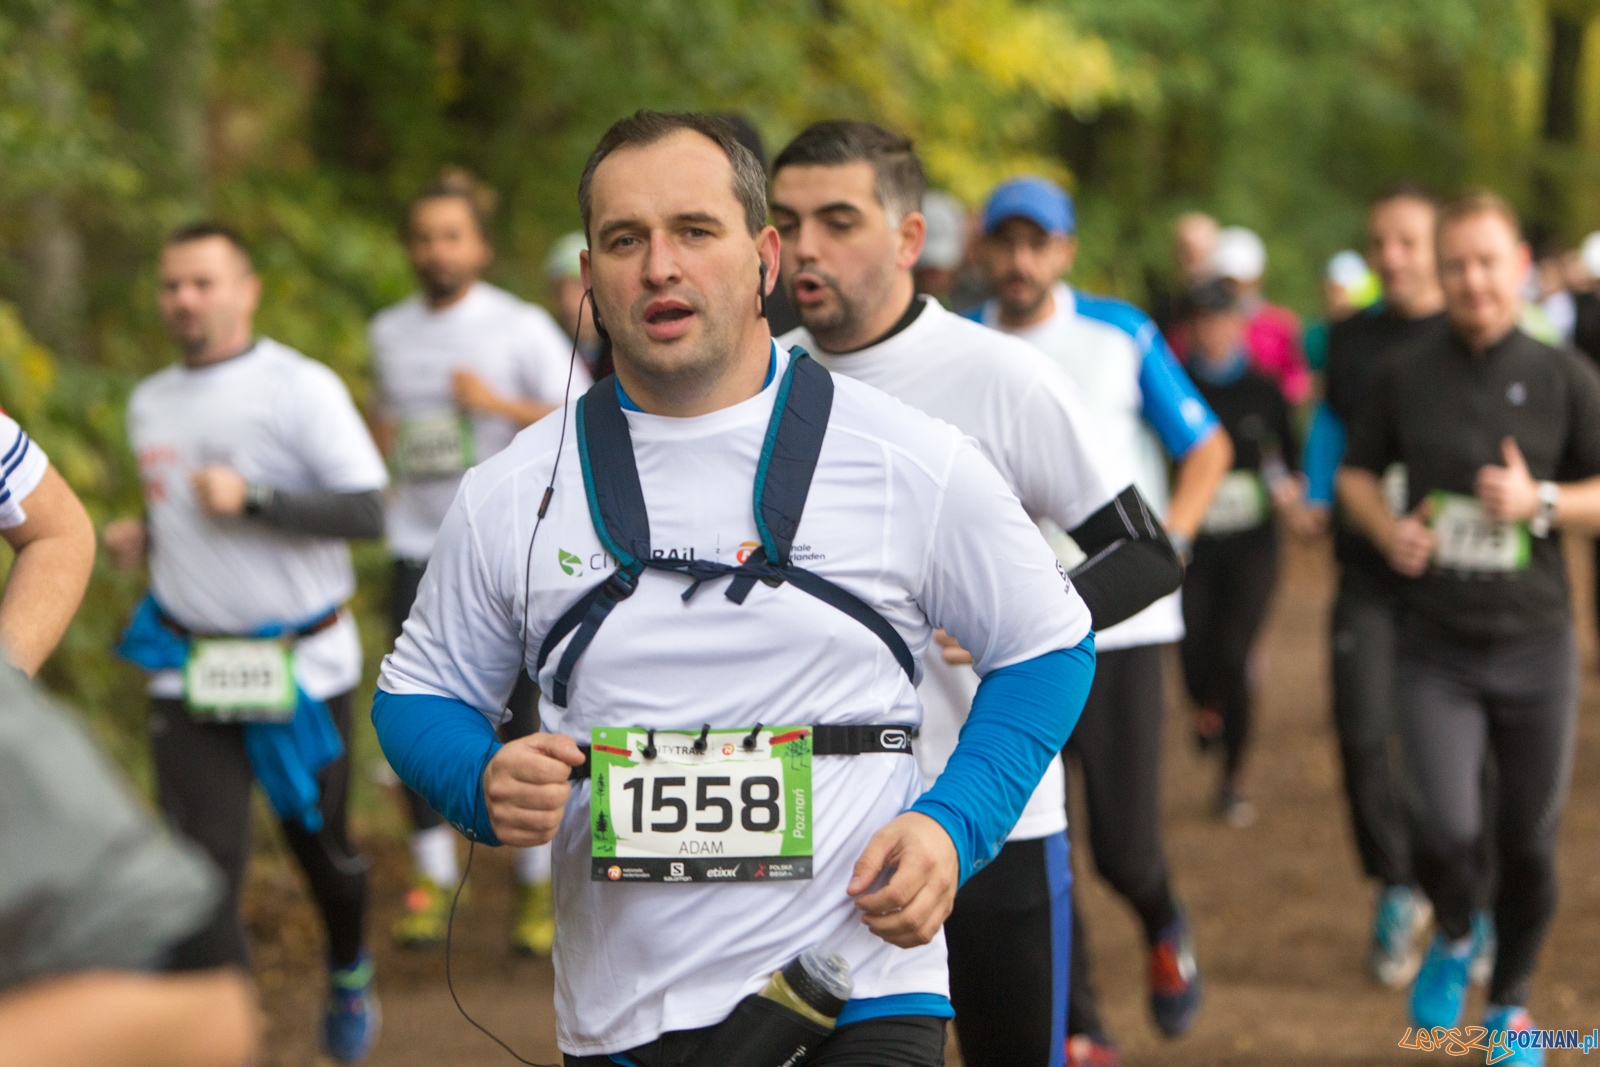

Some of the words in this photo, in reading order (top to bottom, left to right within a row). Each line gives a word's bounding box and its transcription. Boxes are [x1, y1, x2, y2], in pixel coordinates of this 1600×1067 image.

[623, 775, 780, 833] 1558
[792, 788, 806, 839] Poznań
[678, 840, 725, 855] ADAM
